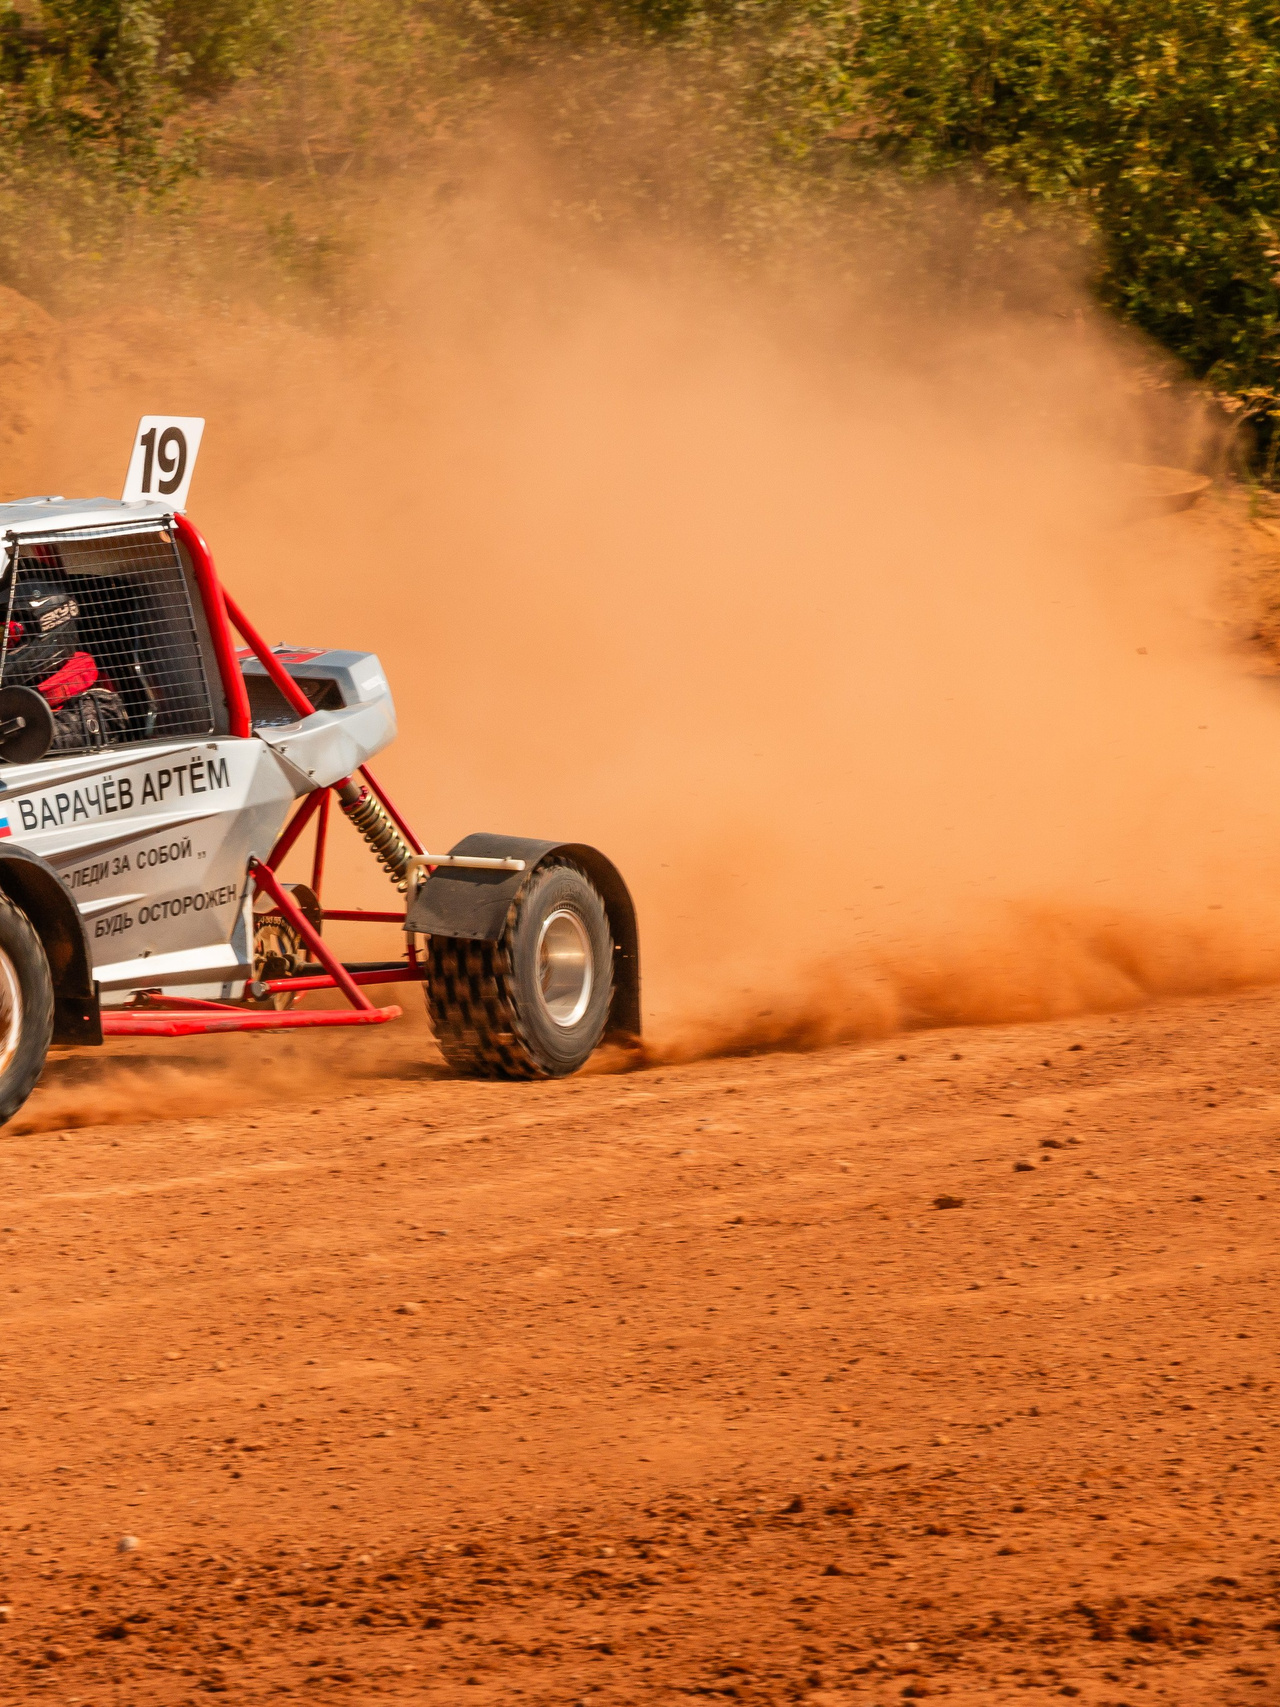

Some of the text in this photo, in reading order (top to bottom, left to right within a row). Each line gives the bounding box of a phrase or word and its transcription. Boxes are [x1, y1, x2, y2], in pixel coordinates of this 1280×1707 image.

[140, 426, 187, 495] 19
[18, 756, 231, 831] ВАРАЧЁВ АРТЁМ
[112, 854, 131, 876] ЗА
[136, 836, 193, 870] СОБОЙ
[94, 884, 238, 939] БУДЬ ОСТОРОЖЕН
